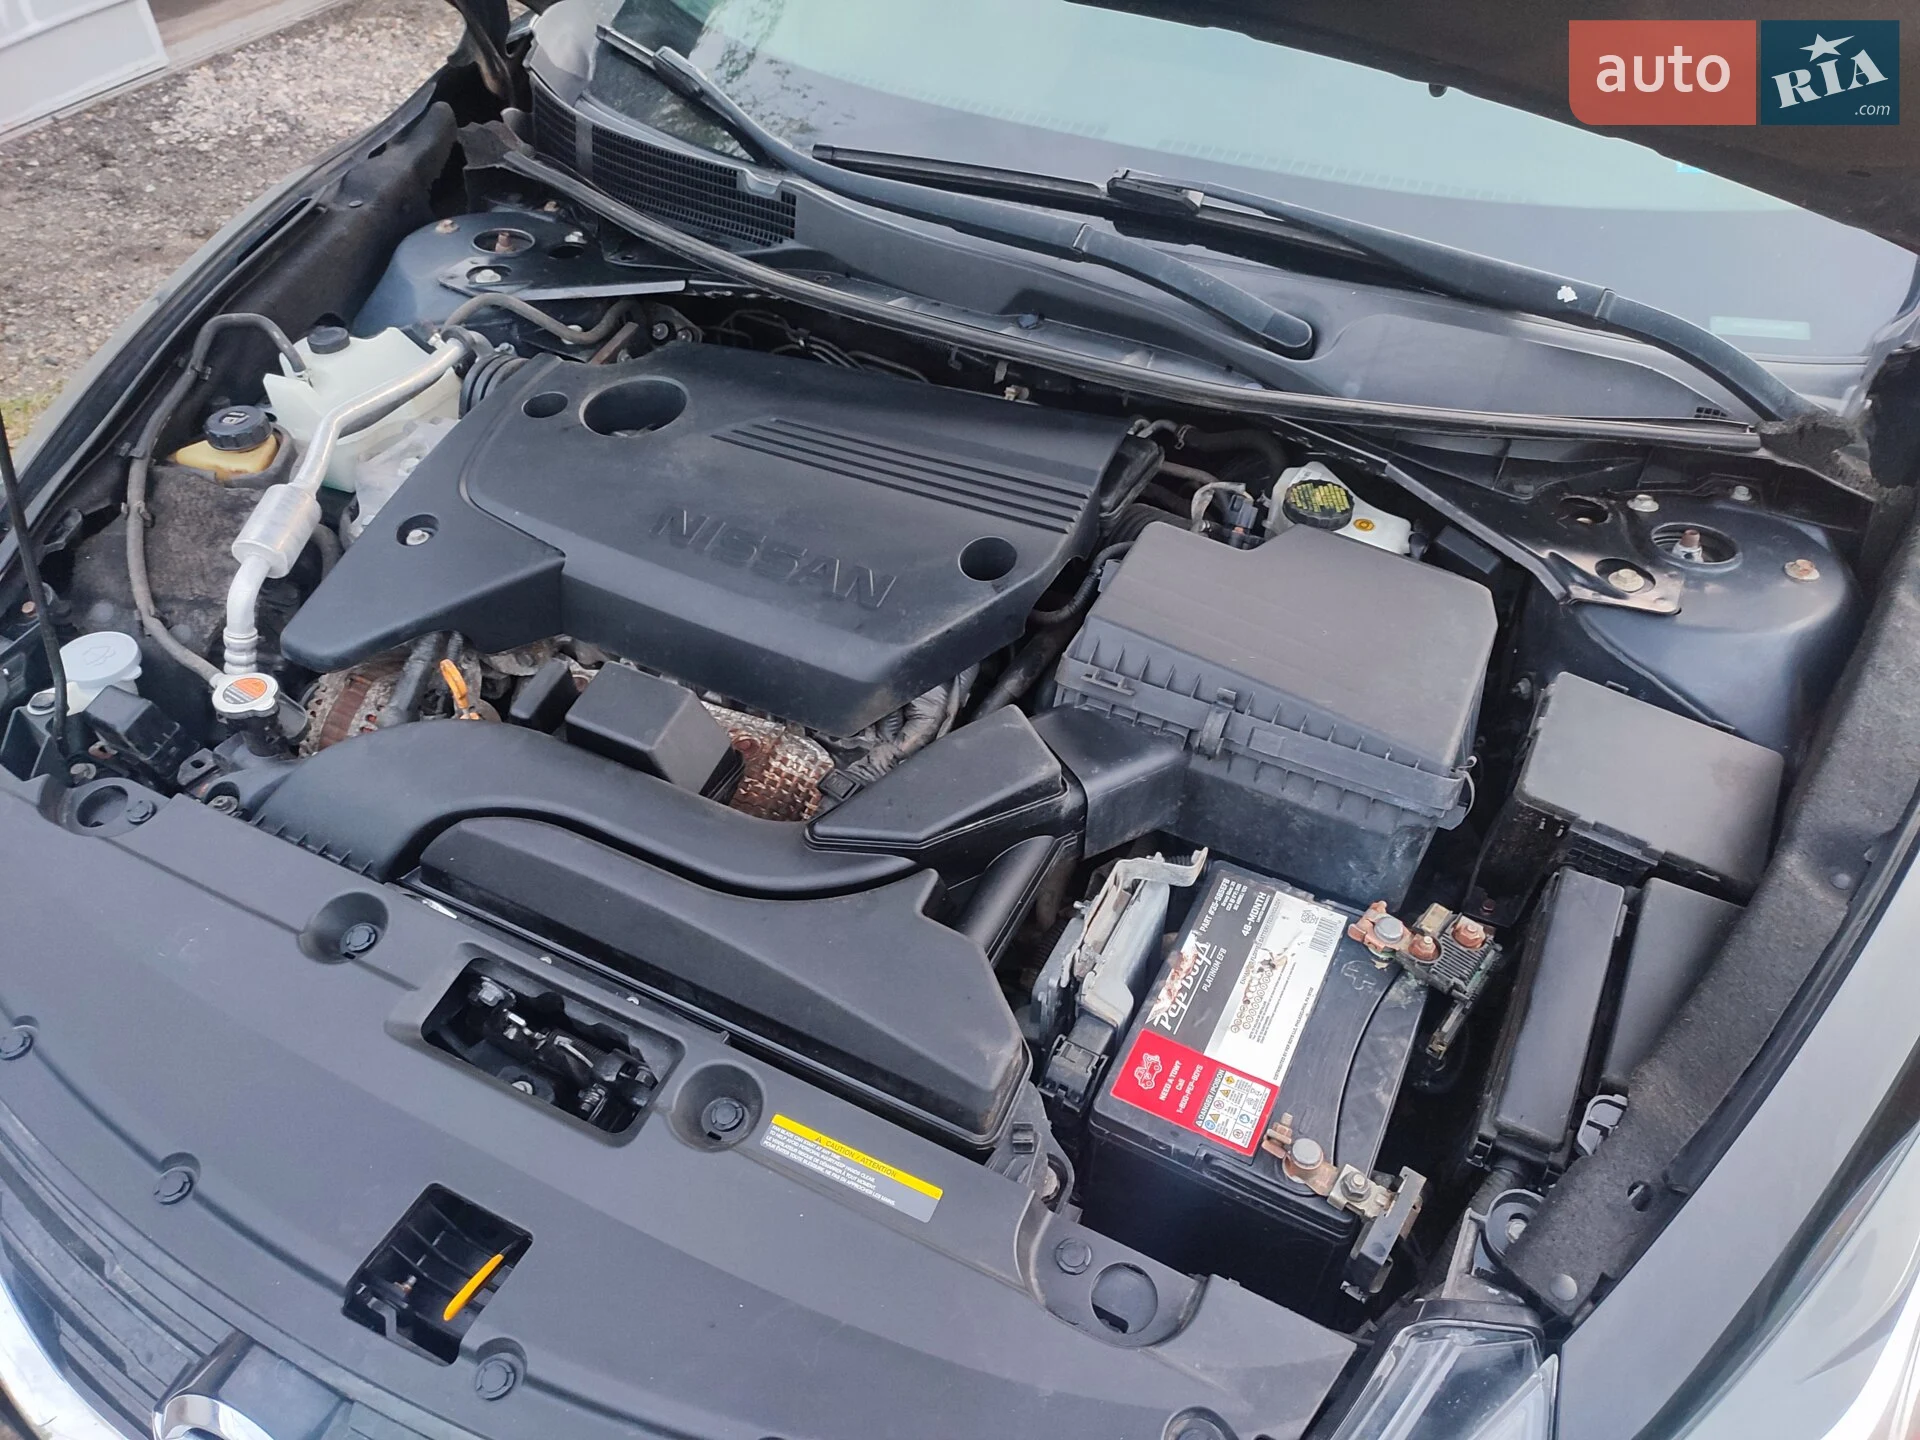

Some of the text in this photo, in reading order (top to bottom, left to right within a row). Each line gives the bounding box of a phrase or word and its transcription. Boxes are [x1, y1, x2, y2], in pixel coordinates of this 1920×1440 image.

[649, 505, 898, 609] NISSAN
[1198, 914, 1213, 932] PART
[1240, 891, 1267, 937] 48-MONTH
[1257, 923, 1270, 942] BATTERY
[1201, 947, 1227, 992] PLATINUM EFB
[1158, 1082, 1171, 1100] NEED
[1168, 1059, 1182, 1078] TOW?
[1175, 1077, 1185, 1091] Call
[1176, 1063, 1203, 1114] 1-800-PEP-BOYS
[1197, 1093, 1214, 1120] DANGER
[825, 1140, 855, 1158] CAUTION
[859, 1156, 897, 1177] ATTENTION
